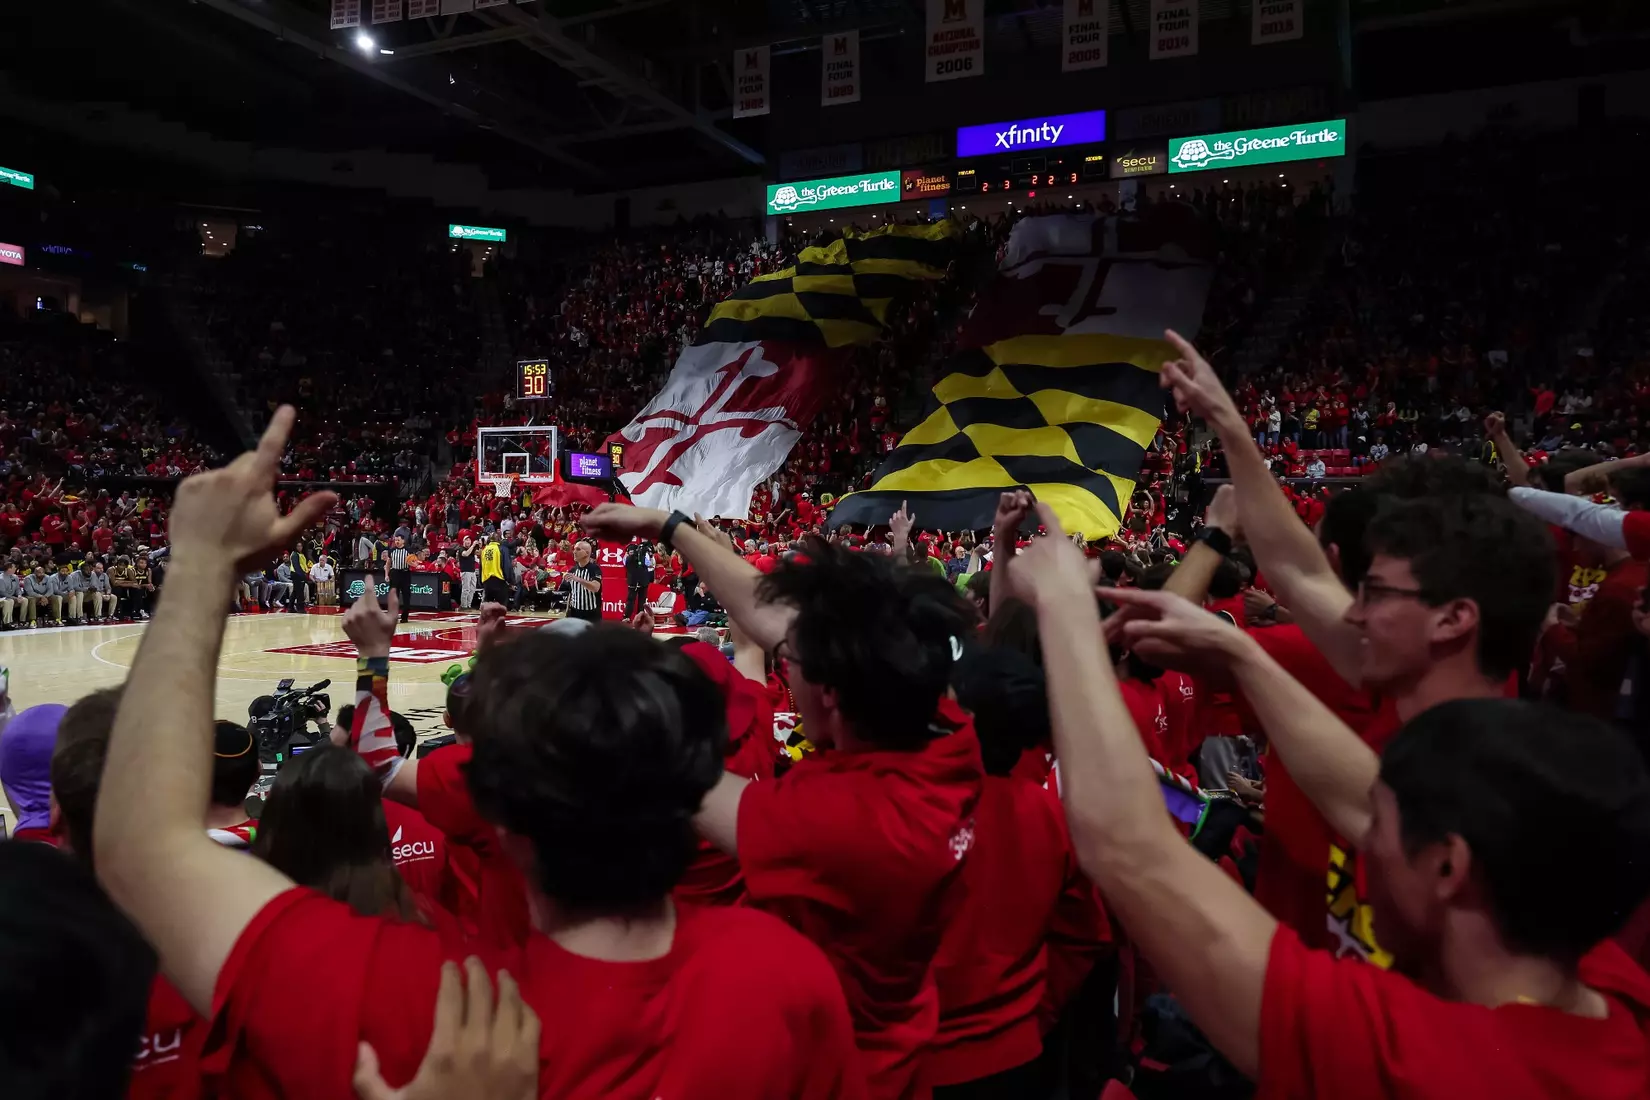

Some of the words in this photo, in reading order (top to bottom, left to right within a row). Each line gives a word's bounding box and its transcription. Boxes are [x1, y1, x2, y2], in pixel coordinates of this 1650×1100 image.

[1156, 9, 1191, 21] FINAL
[1068, 21, 1103, 34] FINAL
[1158, 20, 1189, 32] FOUR
[932, 27, 976, 44] NATIONAL
[1070, 33, 1100, 45] FOUR
[928, 39, 981, 57] CHAMPIONS
[1157, 35, 1190, 51] 2014
[826, 60, 854, 72] FINAL
[935, 57, 974, 75] 2006
[738, 74, 764, 85] FINAL
[828, 70, 853, 82] FOUR
[739, 84, 763, 95] FOUR
[995, 121, 1064, 149] xfinity
[1213, 139, 1233, 152] the
[1233, 136, 1290, 156] Greene
[1290, 128, 1339, 147] Turtle
[1122, 156, 1156, 167] secu
[916, 175, 946, 187] planet
[1032, 175, 1038, 185] 2
[1071, 172, 1077, 182] 3
[801, 186, 815, 198] the
[816, 183, 859, 200] Greene
[858, 177, 895, 193] Turtle
[920, 182, 950, 192] fitness
[982, 182, 989, 192] 2
[1004, 180, 1010, 189] 3
[0, 248, 22, 260] YOTA
[524, 363, 546, 375] 15:53
[524, 376, 543, 395] 30
[579, 456, 597, 467] planet
[582, 466, 601, 476] fitness
[602, 599, 626, 613] init
[391, 840, 435, 860] secu
[133, 1028, 181, 1060] cu
